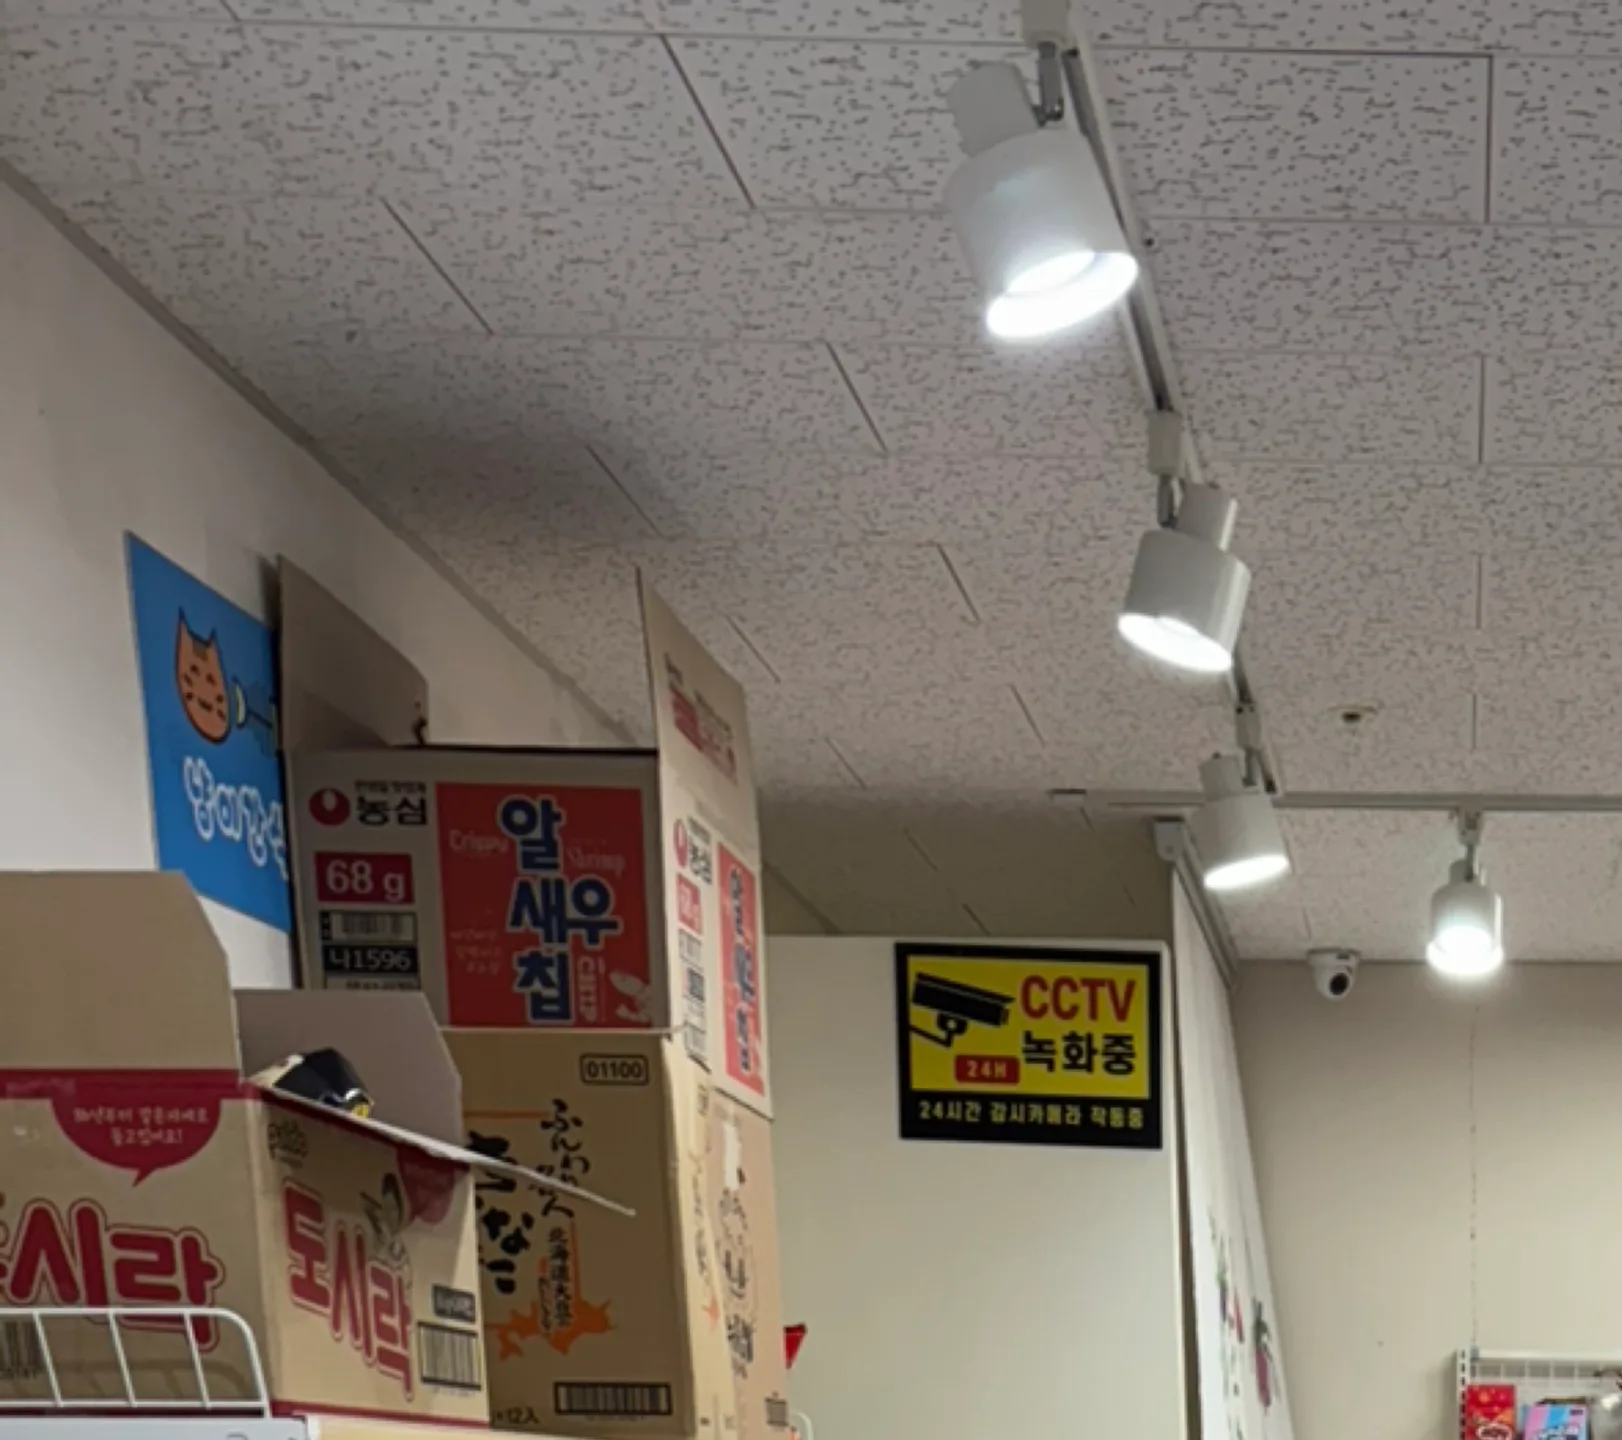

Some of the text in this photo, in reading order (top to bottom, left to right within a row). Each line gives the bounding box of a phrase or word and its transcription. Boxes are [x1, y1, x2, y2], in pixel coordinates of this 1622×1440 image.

[357, 796, 428, 826] 농심
[499, 797, 564, 870] 알
[326, 860, 374, 894] 68
[506, 876, 622, 946] 새우
[328, 950, 413, 970] 나1596
[514, 950, 573, 1020] 칩
[1019, 974, 1137, 1023] CCTV
[585, 1061, 643, 1079] 01100
[965, 1060, 1008, 1079] 24H
[1021, 1030, 1137, 1076] 녹화중
[918, 1100, 982, 1123] 24시간
[0, 1198, 222, 1350] 시락
[284, 1179, 415, 1400] 도시락
